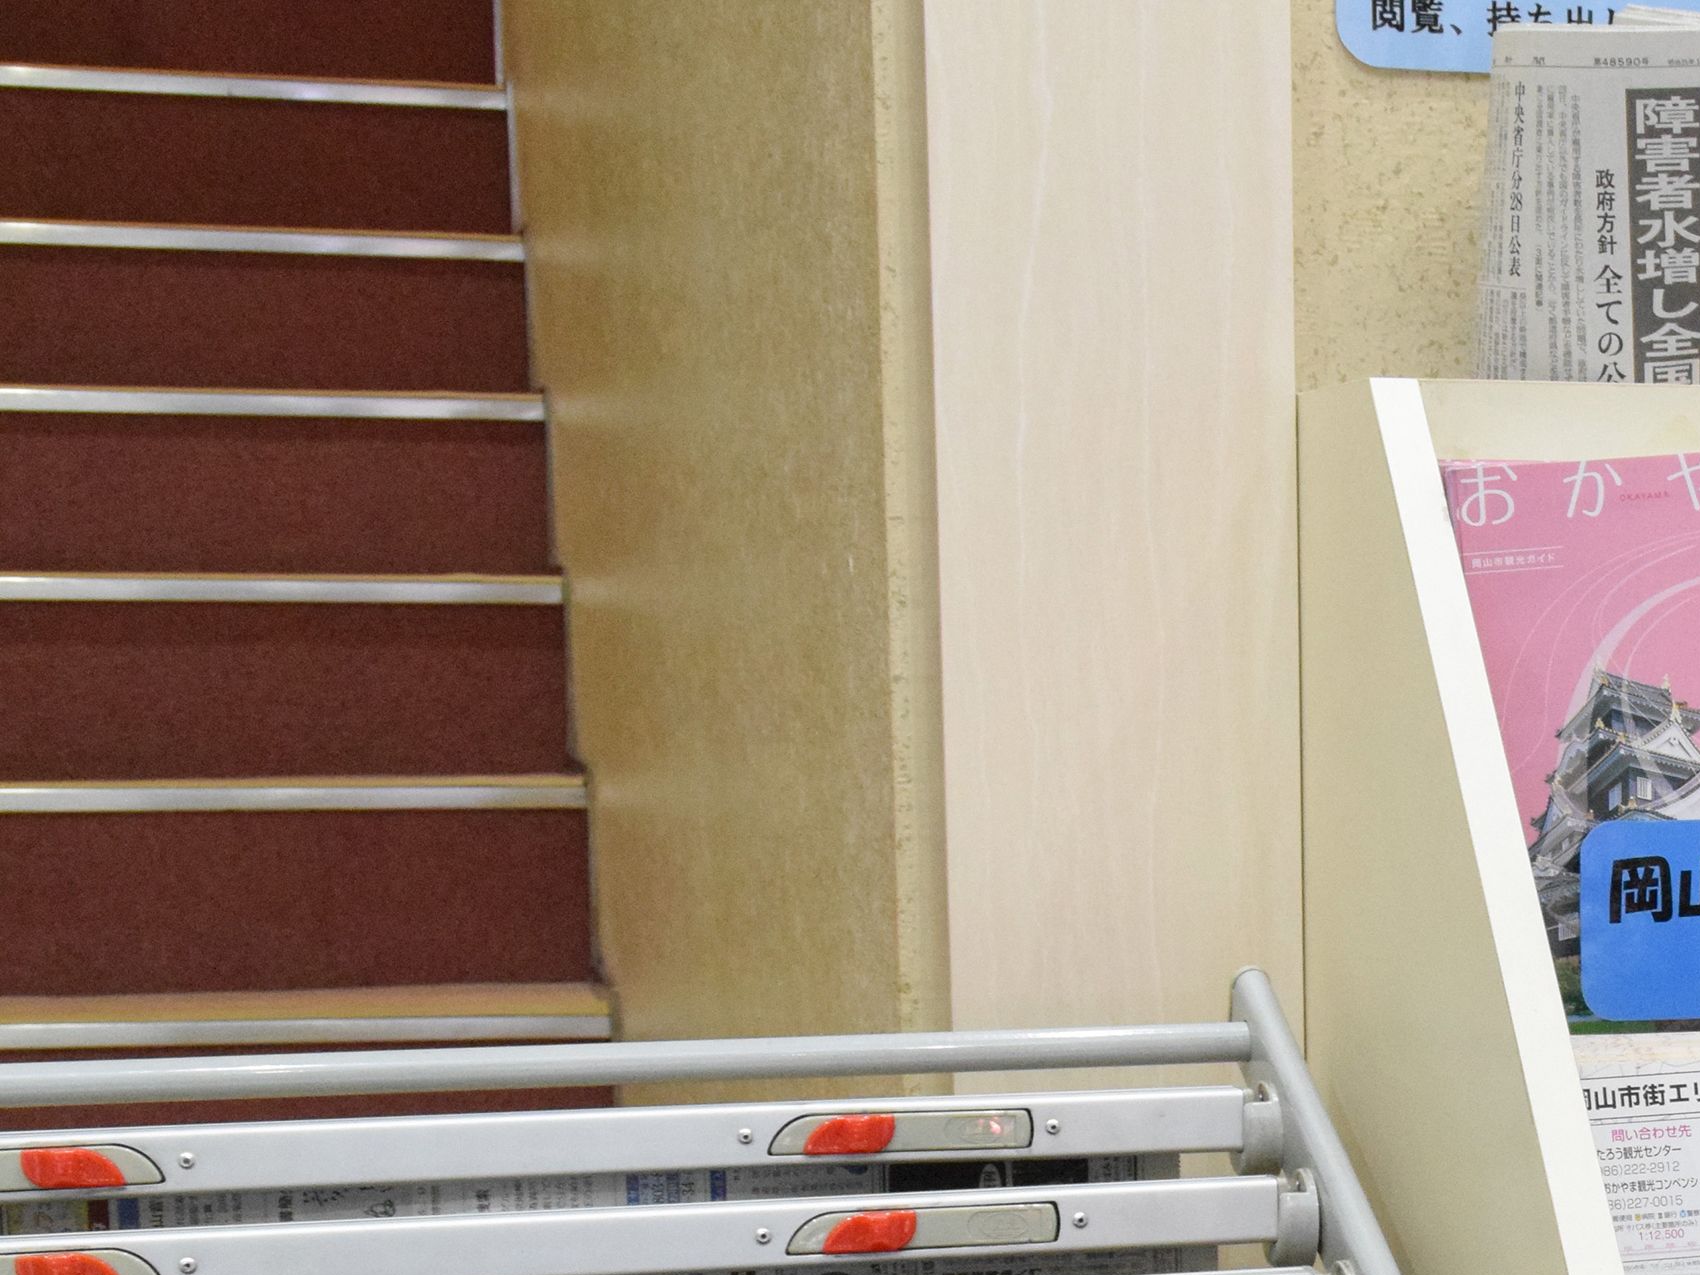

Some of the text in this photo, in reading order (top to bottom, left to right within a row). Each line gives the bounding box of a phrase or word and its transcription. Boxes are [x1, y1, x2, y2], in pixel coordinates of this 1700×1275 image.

[1508, 80, 1526, 278] 中央省庁分28日公表
[1594, 169, 1627, 384] 政府方針 全ての公
[1619, 490, 1670, 502] OKAYAMA
[1611, 1124, 1693, 1143] 問い合わせ先
[1600, 1160, 1681, 1177] 86)222-2912
